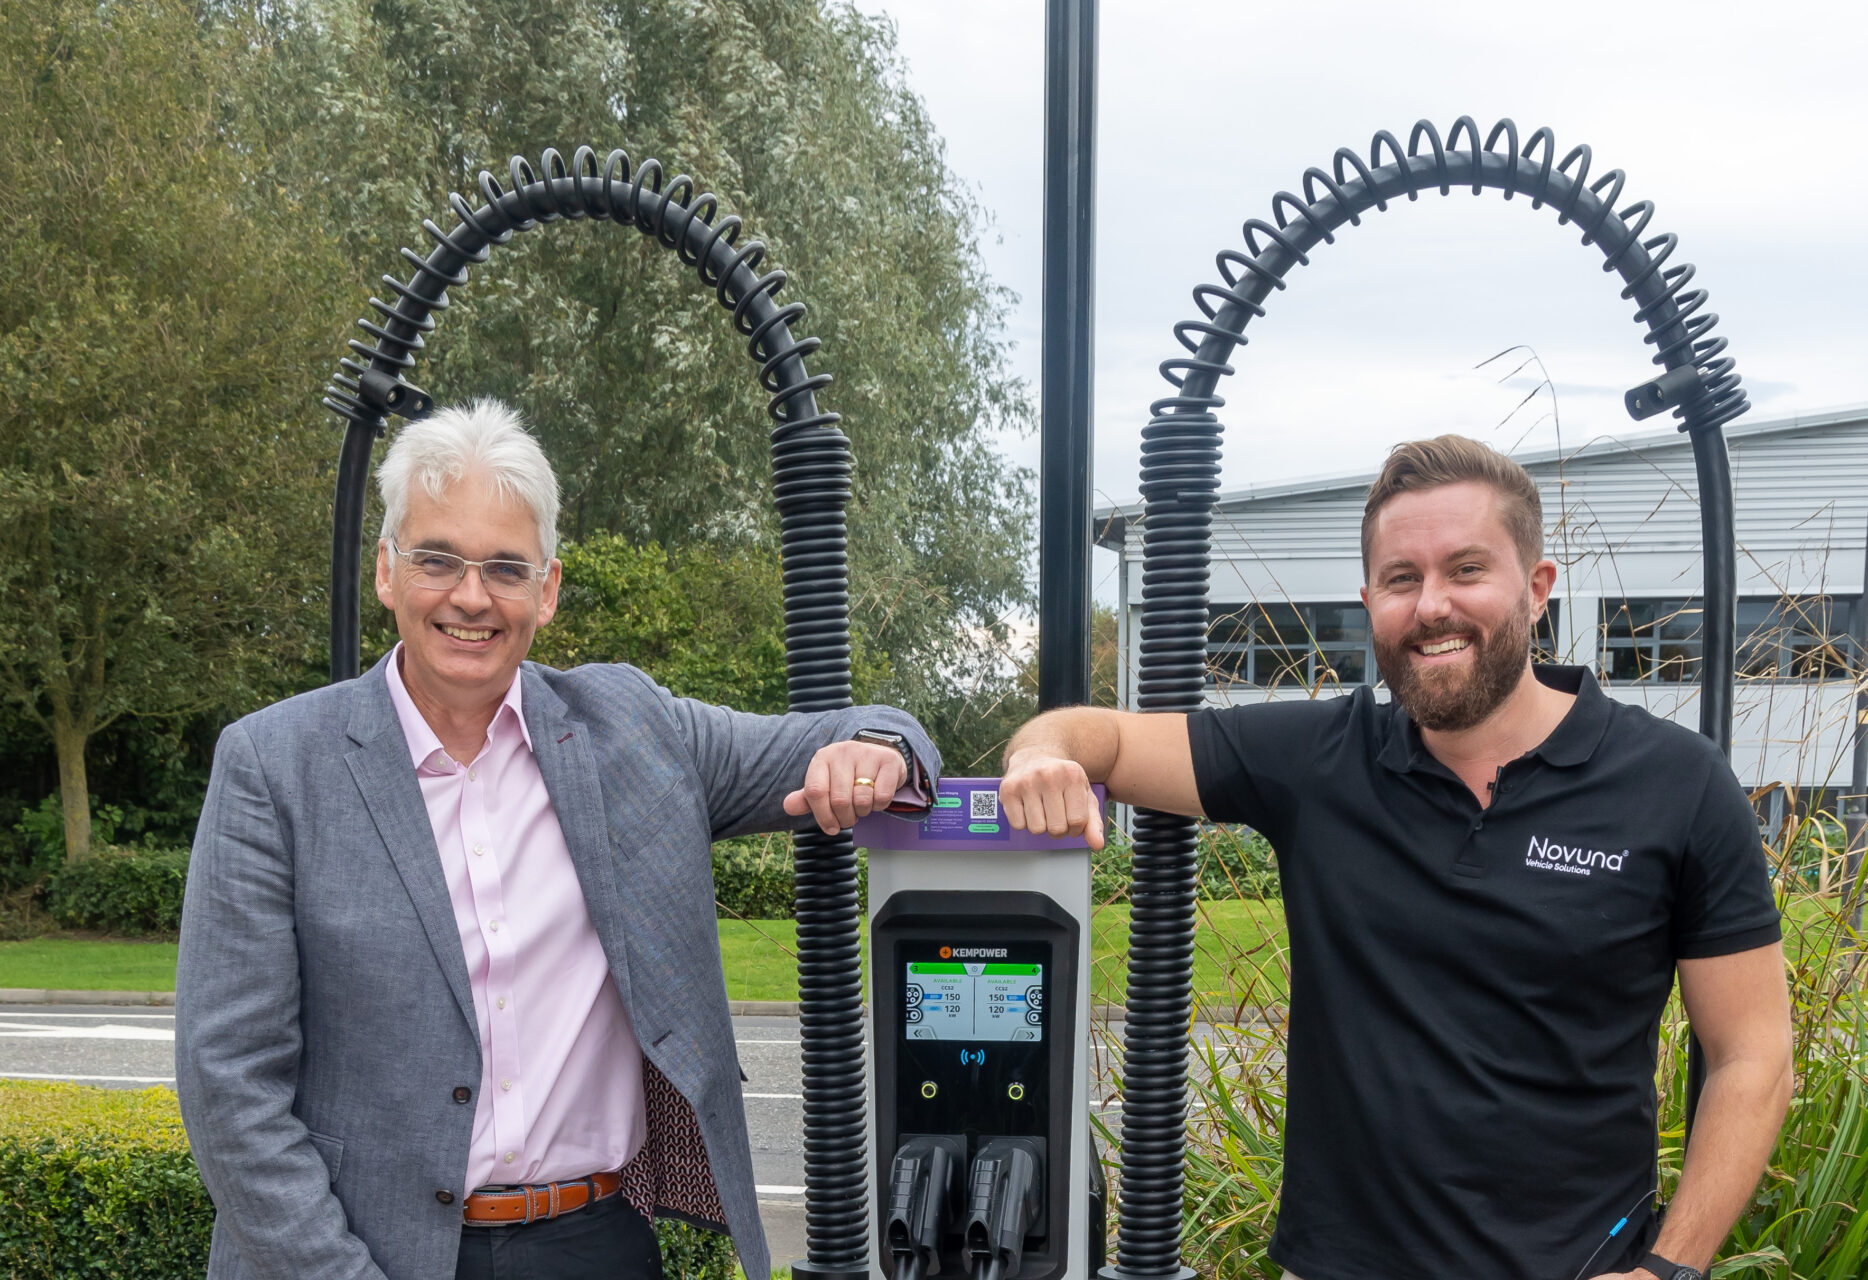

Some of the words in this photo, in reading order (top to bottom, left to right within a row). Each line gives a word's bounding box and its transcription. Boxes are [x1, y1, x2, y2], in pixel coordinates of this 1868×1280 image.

[1527, 835, 1623, 872] Novuna
[1525, 857, 1553, 870] Vehicle
[1553, 862, 1591, 876] Solutions
[952, 948, 1007, 958] KEMPOWER
[944, 993, 960, 1001] 150
[988, 994, 1004, 1002] 150
[944, 1005, 960, 1013] 120
[988, 1006, 1004, 1014] 120
